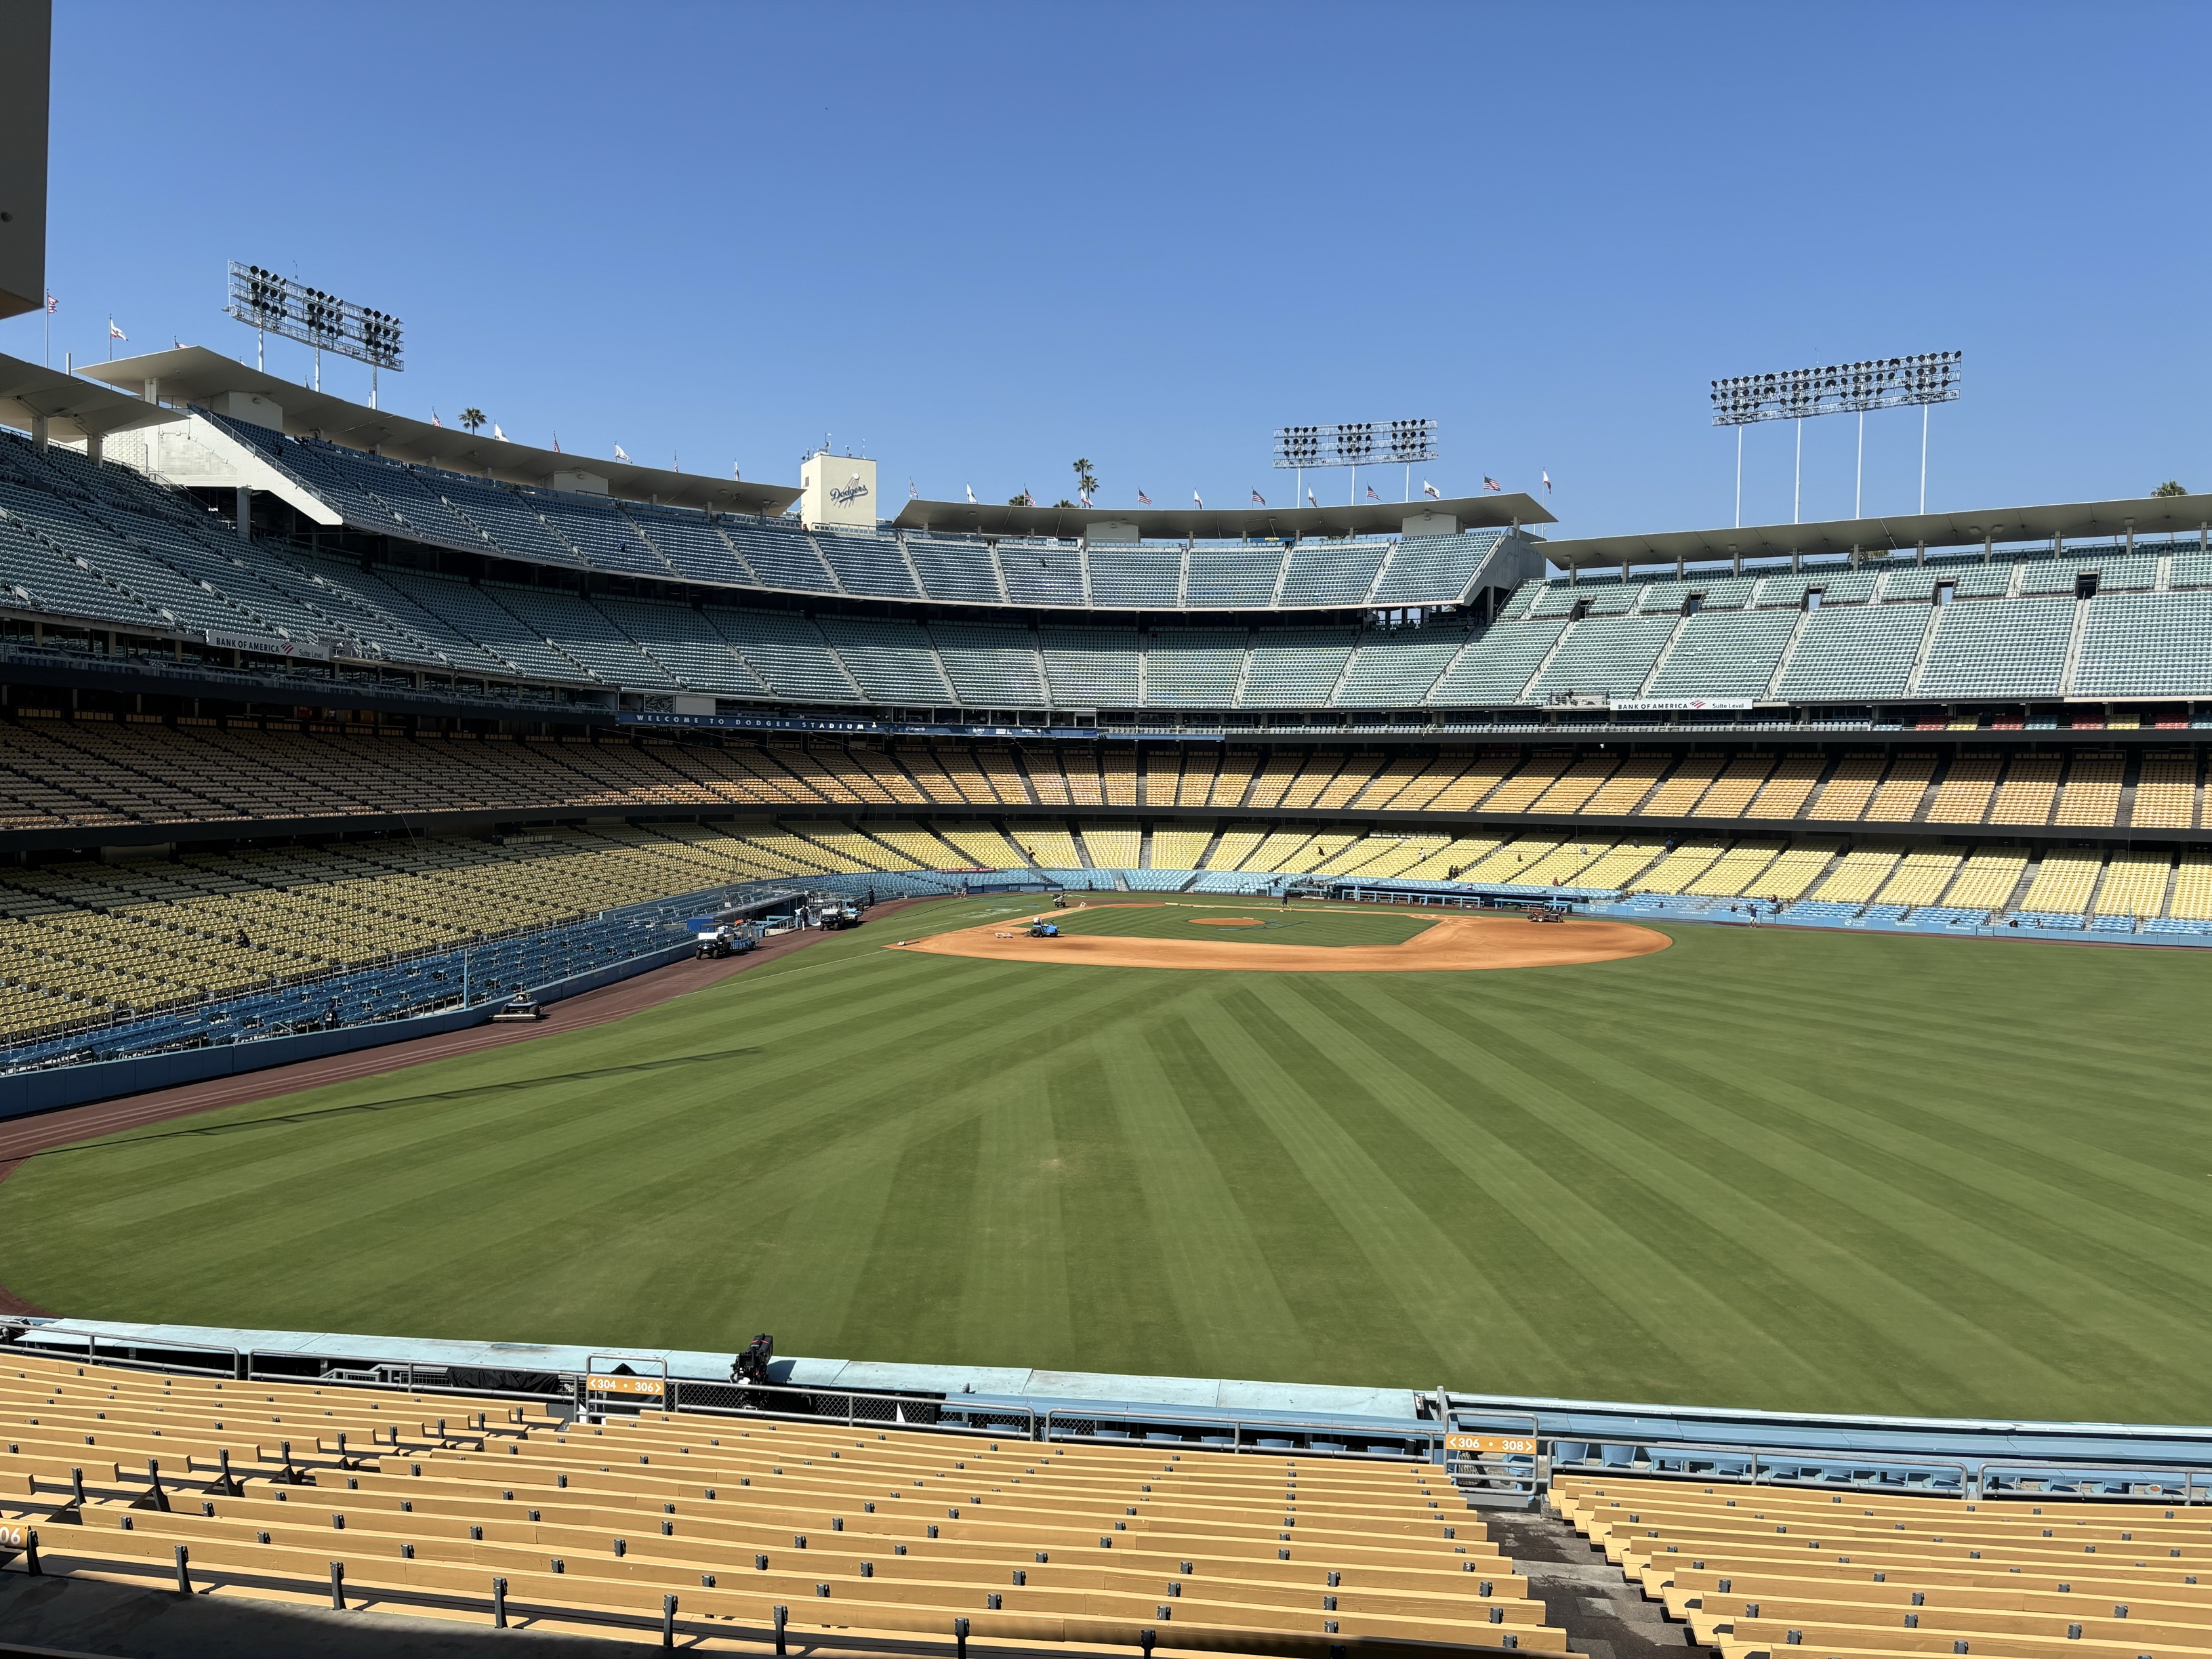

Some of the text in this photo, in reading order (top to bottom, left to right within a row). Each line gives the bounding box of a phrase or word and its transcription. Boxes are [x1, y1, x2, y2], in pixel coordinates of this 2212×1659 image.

[830, 485, 868, 504] Dodgers
[216, 637, 280, 653] BANK OF AMERICA
[299, 649, 323, 659] Suite Level
[636, 714, 699, 723] WELCOME
[735, 719, 790, 727] DODGER
[802, 722, 864, 730] STADIUM
[598, 1378, 653, 1392] 304 306
[1458, 1437, 1523, 1451] 306 308
